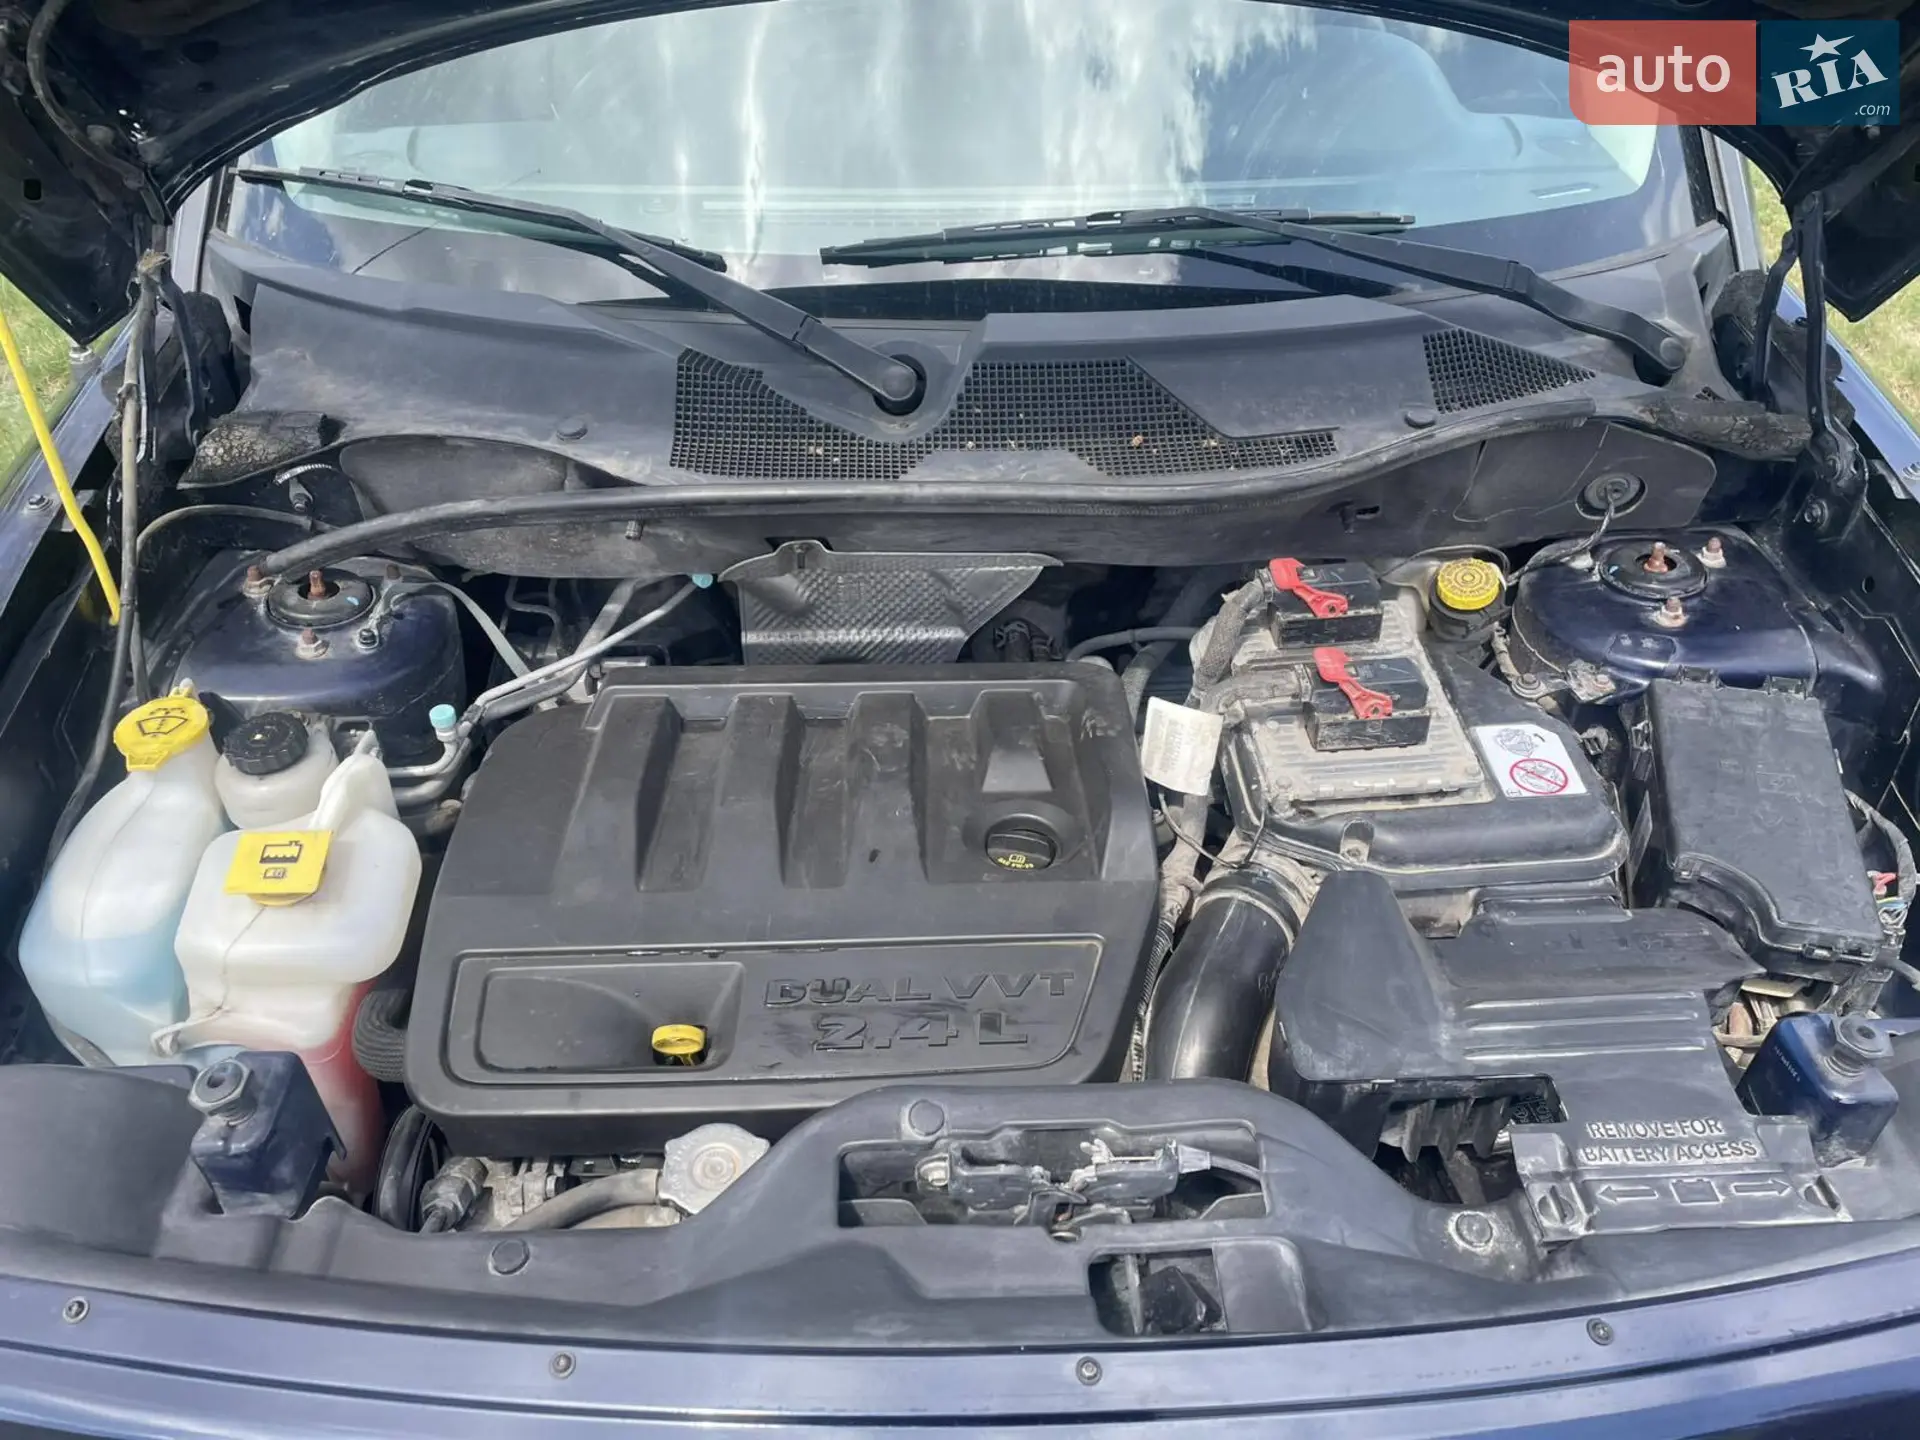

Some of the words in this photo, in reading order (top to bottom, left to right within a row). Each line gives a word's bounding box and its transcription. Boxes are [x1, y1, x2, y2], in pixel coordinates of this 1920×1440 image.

[765, 977, 931, 1005] DUAL
[943, 972, 1075, 998] VVT
[1587, 1120, 1677, 1139] REMOVE
[1680, 1117, 1725, 1136] FOR
[1580, 1145, 1669, 1164] BATTERY
[1676, 1139, 1758, 1161] ACCESS
